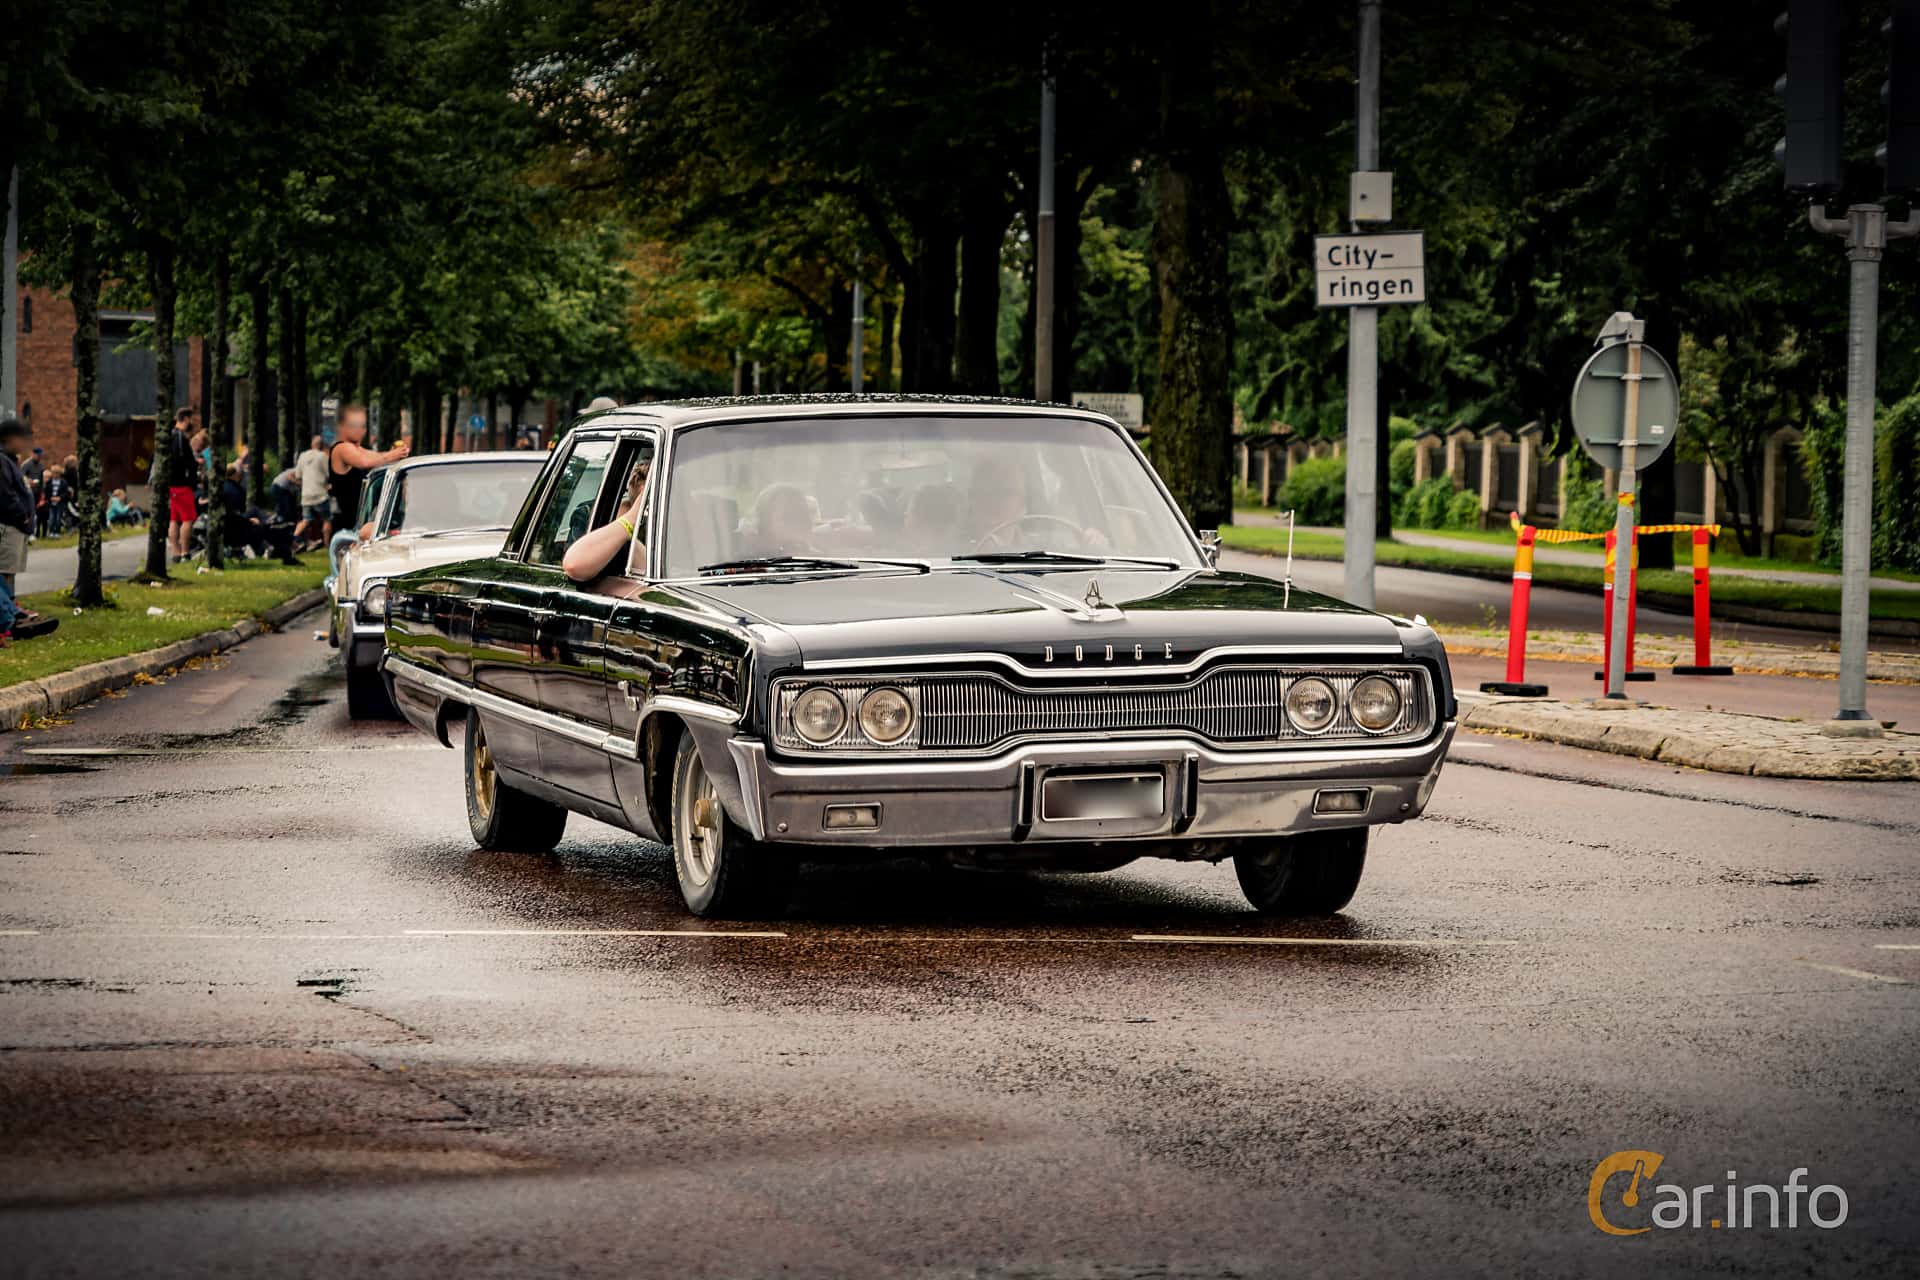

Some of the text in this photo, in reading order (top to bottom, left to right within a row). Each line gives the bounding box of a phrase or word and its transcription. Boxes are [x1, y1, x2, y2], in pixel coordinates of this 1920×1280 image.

[1328, 245, 1394, 270] City-
[1329, 276, 1413, 300] ringen
[1045, 642, 1173, 662] DODGE
